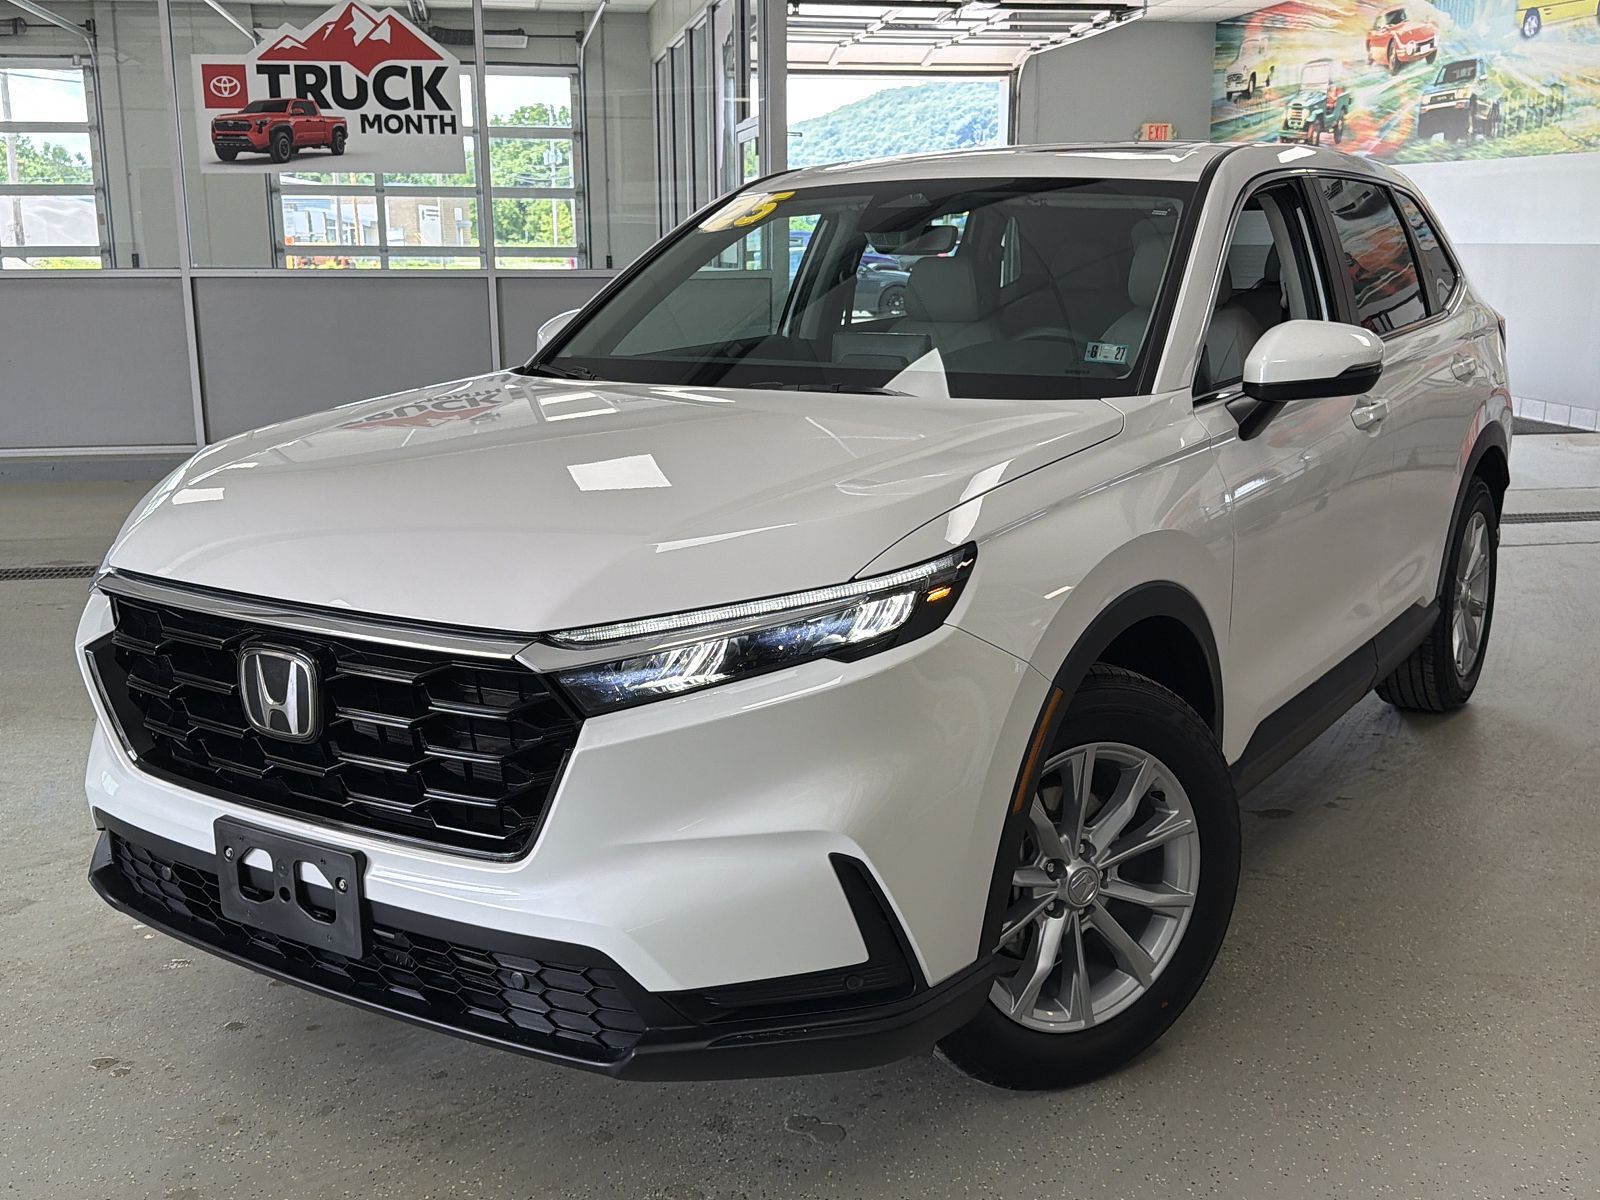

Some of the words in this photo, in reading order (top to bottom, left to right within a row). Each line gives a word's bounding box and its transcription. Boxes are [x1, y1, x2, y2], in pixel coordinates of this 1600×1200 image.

[256, 64, 453, 111] TRUCK
[360, 113, 457, 135] MONTH
[1149, 125, 1168, 140] EXIT
[1115, 346, 1126, 360] 27
